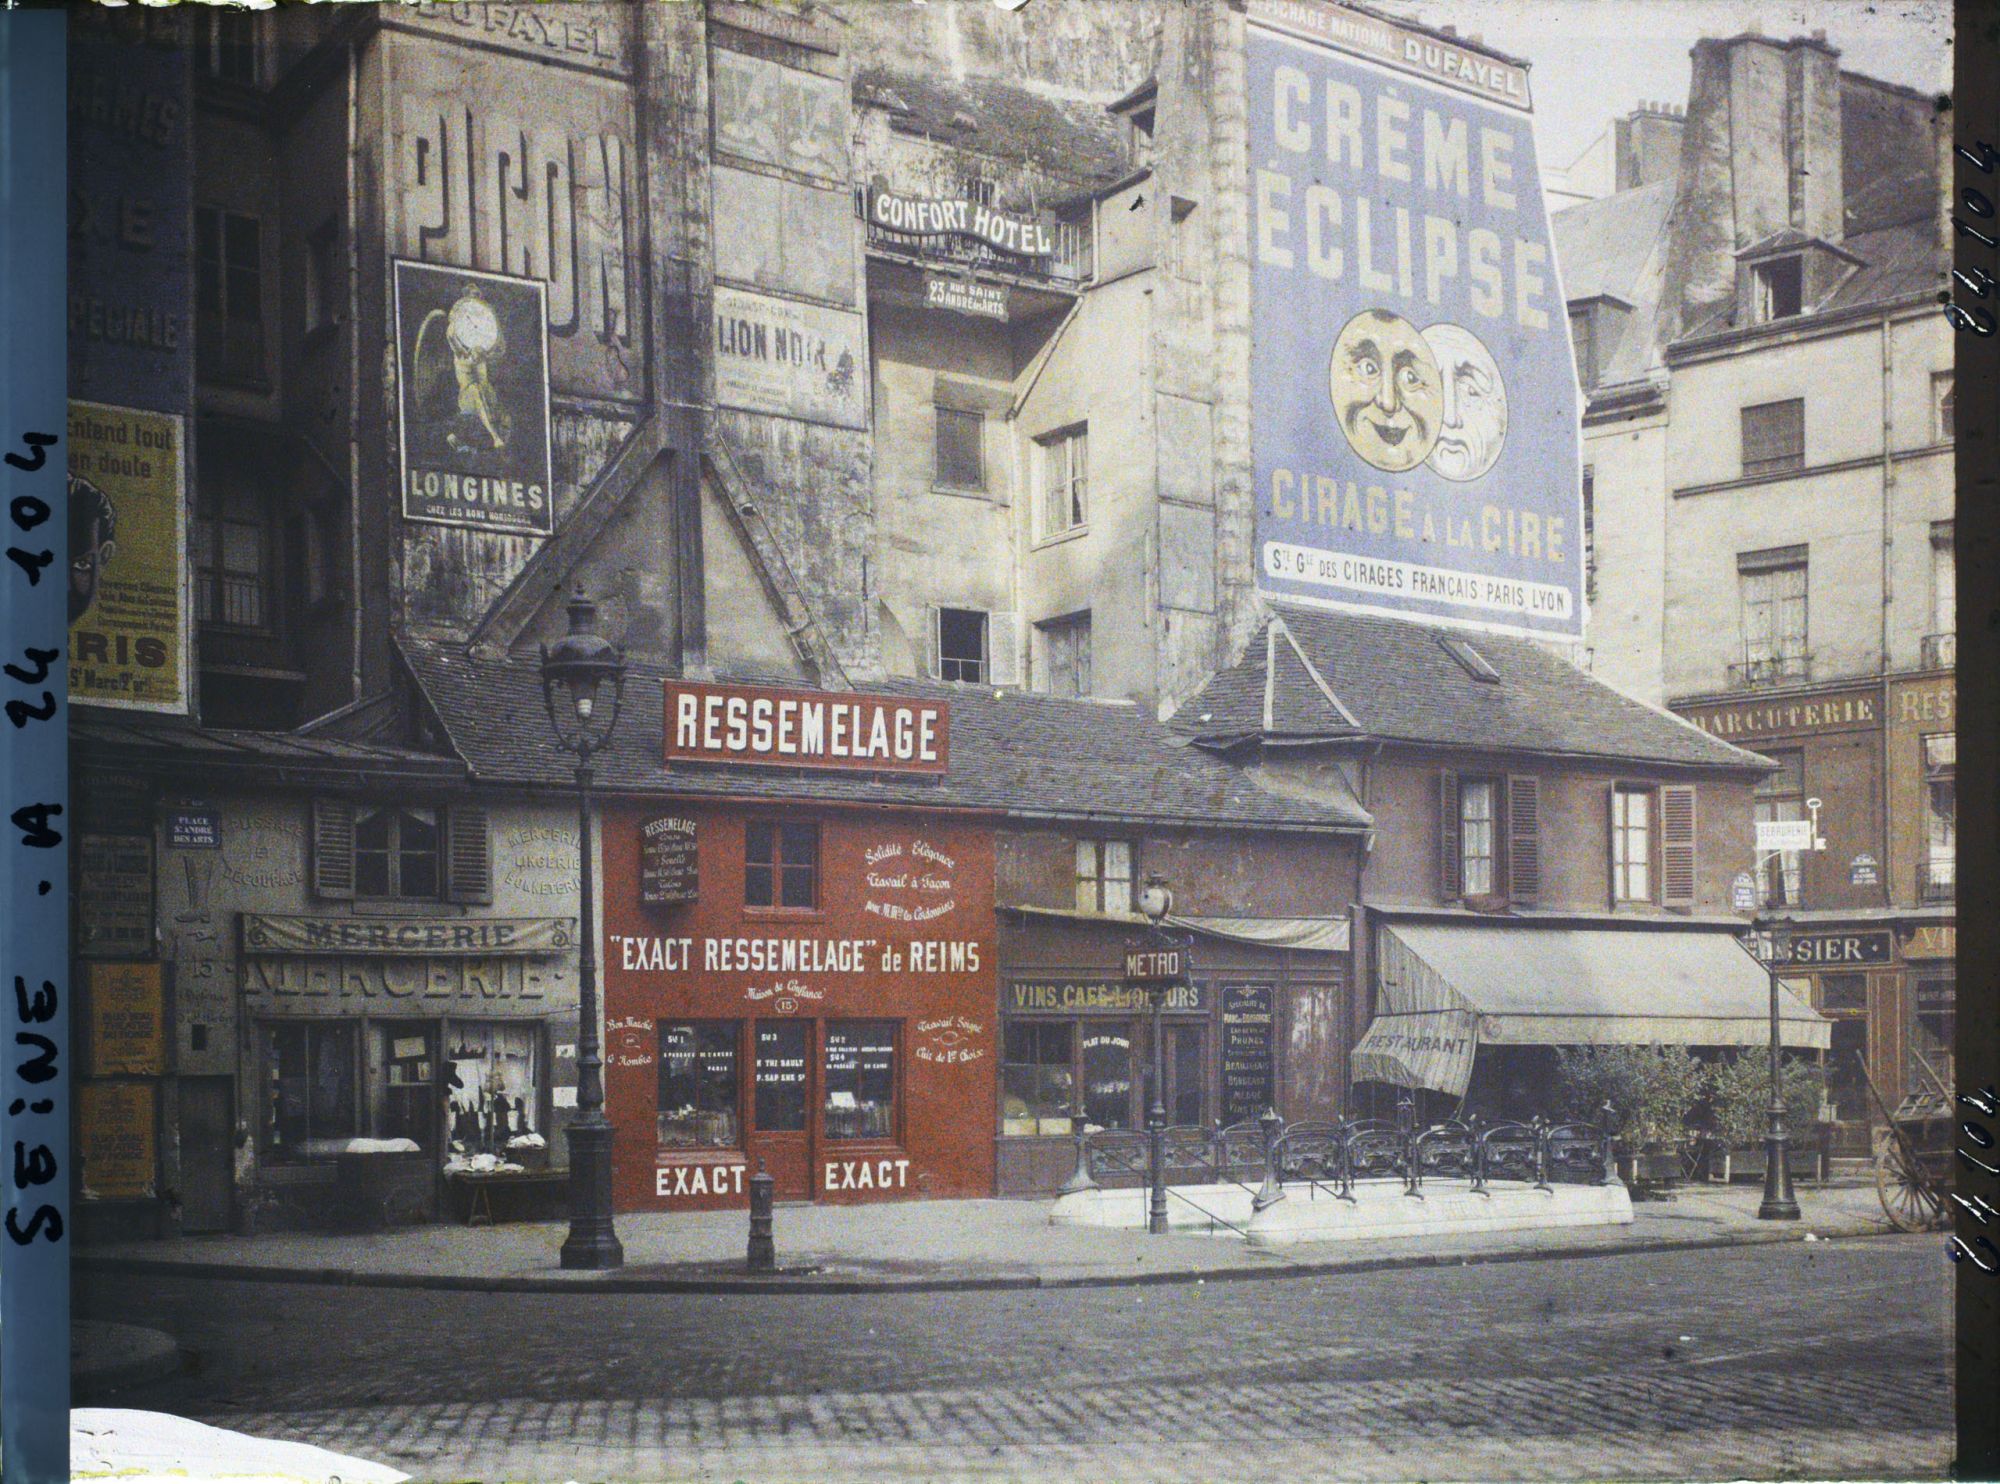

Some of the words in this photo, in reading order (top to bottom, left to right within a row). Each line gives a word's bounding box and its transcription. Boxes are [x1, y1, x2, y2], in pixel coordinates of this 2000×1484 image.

[1331, 17, 1395, 54] NATIONAL
[1404, 37, 1519, 96] DUFAYEL
[877, 194, 968, 231] CONFORT
[973, 206, 1050, 253] HOTEL
[929, 280, 945, 303] 23
[949, 283, 966, 295] RUE
[969, 285, 1002, 299] SAINT
[718, 315, 767, 361] LION
[134, 422, 172, 450] tout
[99, 451, 151, 478] doute
[411, 470, 543, 510] LONGINES
[426, 504, 445, 516] CHEZ
[450, 506, 463, 517] LES
[1270, 467, 1415, 541] CIRAGE
[1446, 515, 1474, 551] LA
[1481, 505, 1566, 562] CIRE
[1319, 560, 1338, 579] DES
[1343, 560, 1404, 588] CIRAGES
[1532, 588, 1565, 612] LYON
[677, 693, 938, 761] RESSEMELAGE
[178, 816, 209, 825] PLACE
[192, 835, 214, 844] ARTS
[508, 828, 581, 850] MERCERI
[504, 871, 581, 895] BONNETERI
[302, 921, 516, 949] MERCERIE
[881, 944, 902, 972] de
[909, 941, 981, 973] REIMS
[1127, 952, 1179, 977] METRO
[243, 956, 544, 1000] MERCERIE
[781, 1001, 792, 1010] 15
[1115, 986, 1199, 1010] LIQURS
[1083, 1036, 1098, 1049] PLAT
[1100, 1036, 1109, 1046] DU
[1111, 1036, 1130, 1049] JOUR
[656, 1165, 746, 1196] EXACT
[825, 1160, 910, 1190] EXACT
